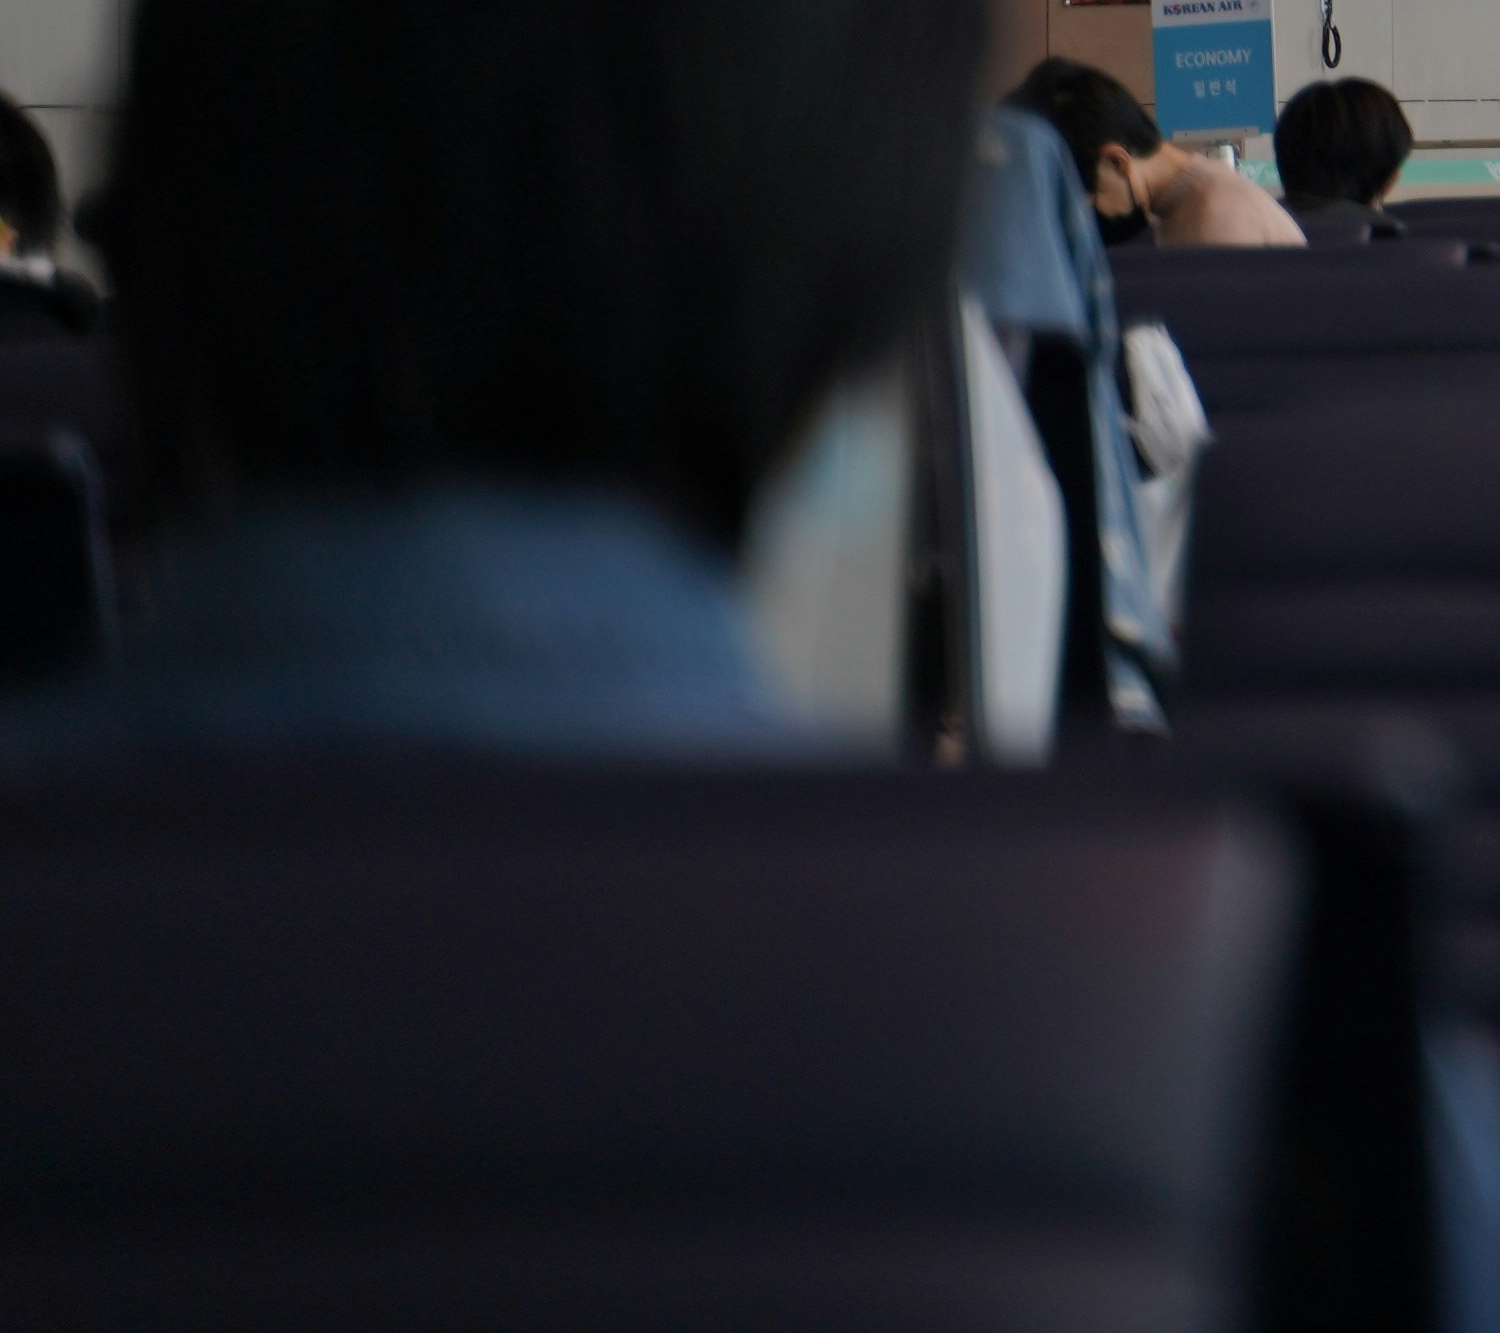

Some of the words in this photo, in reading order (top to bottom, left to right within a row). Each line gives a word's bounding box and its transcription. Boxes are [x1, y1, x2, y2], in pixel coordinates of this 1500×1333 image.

[1163, 2, 1216, 16] KOREAN
[1218, 0, 1243, 13] AIR
[1176, 48, 1252, 69] ECONOMY
